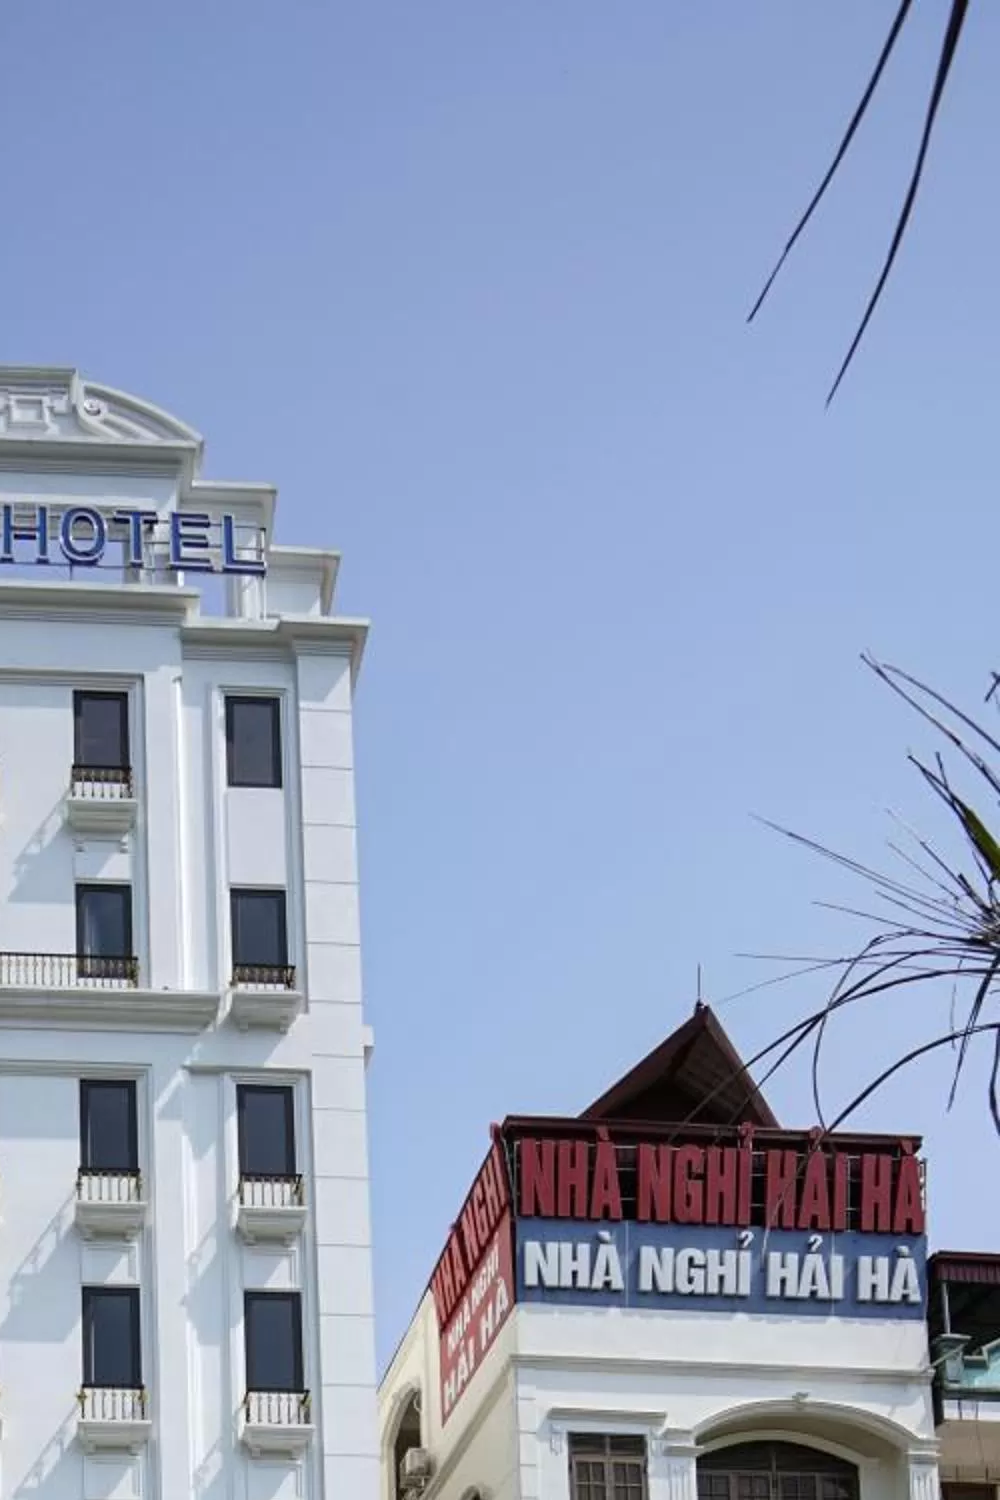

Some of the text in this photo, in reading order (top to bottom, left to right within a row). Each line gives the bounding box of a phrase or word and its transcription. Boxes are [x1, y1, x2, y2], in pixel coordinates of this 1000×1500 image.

[1, 503, 268, 577] HOTEL
[519, 1121, 925, 1234] NHÀ NGHỈ HẢI HÀ
[523, 1230, 922, 1304] NHÀ NGHỈ HẢI HÀ
[481, 1276, 509, 1351] HÀ
